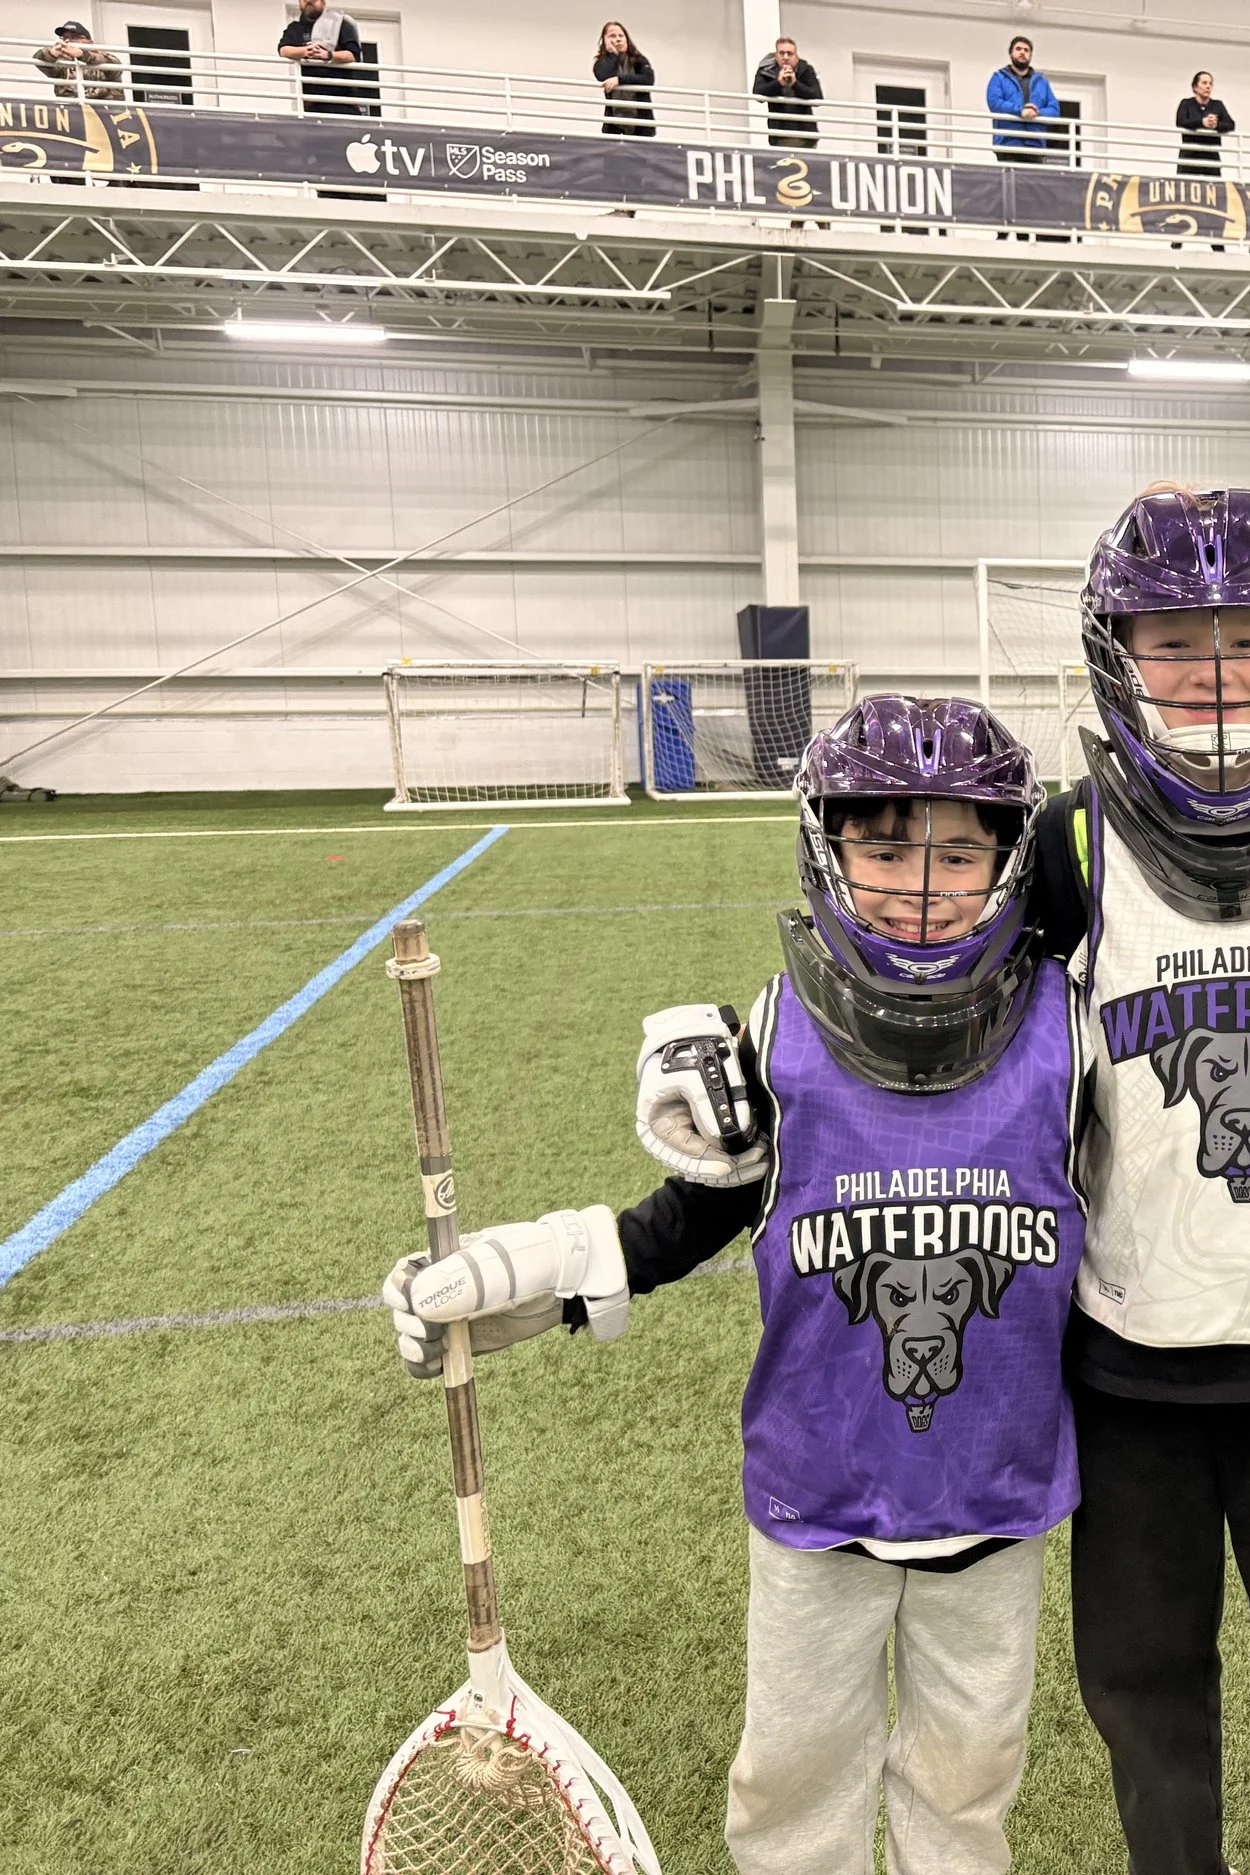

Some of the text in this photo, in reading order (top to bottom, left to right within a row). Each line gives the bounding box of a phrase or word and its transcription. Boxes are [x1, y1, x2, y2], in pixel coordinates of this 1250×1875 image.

[482, 146, 550, 167] Season
[483, 165, 527, 183] Pass
[686, 150, 953, 217] PHL UNION
[1149, 181, 1217, 207] UNION
[835, 1167, 1011, 1204] PHILADELPHIA
[790, 1202, 1058, 1276] WATERDOGS
[418, 1276, 467, 1308] TORQUE
